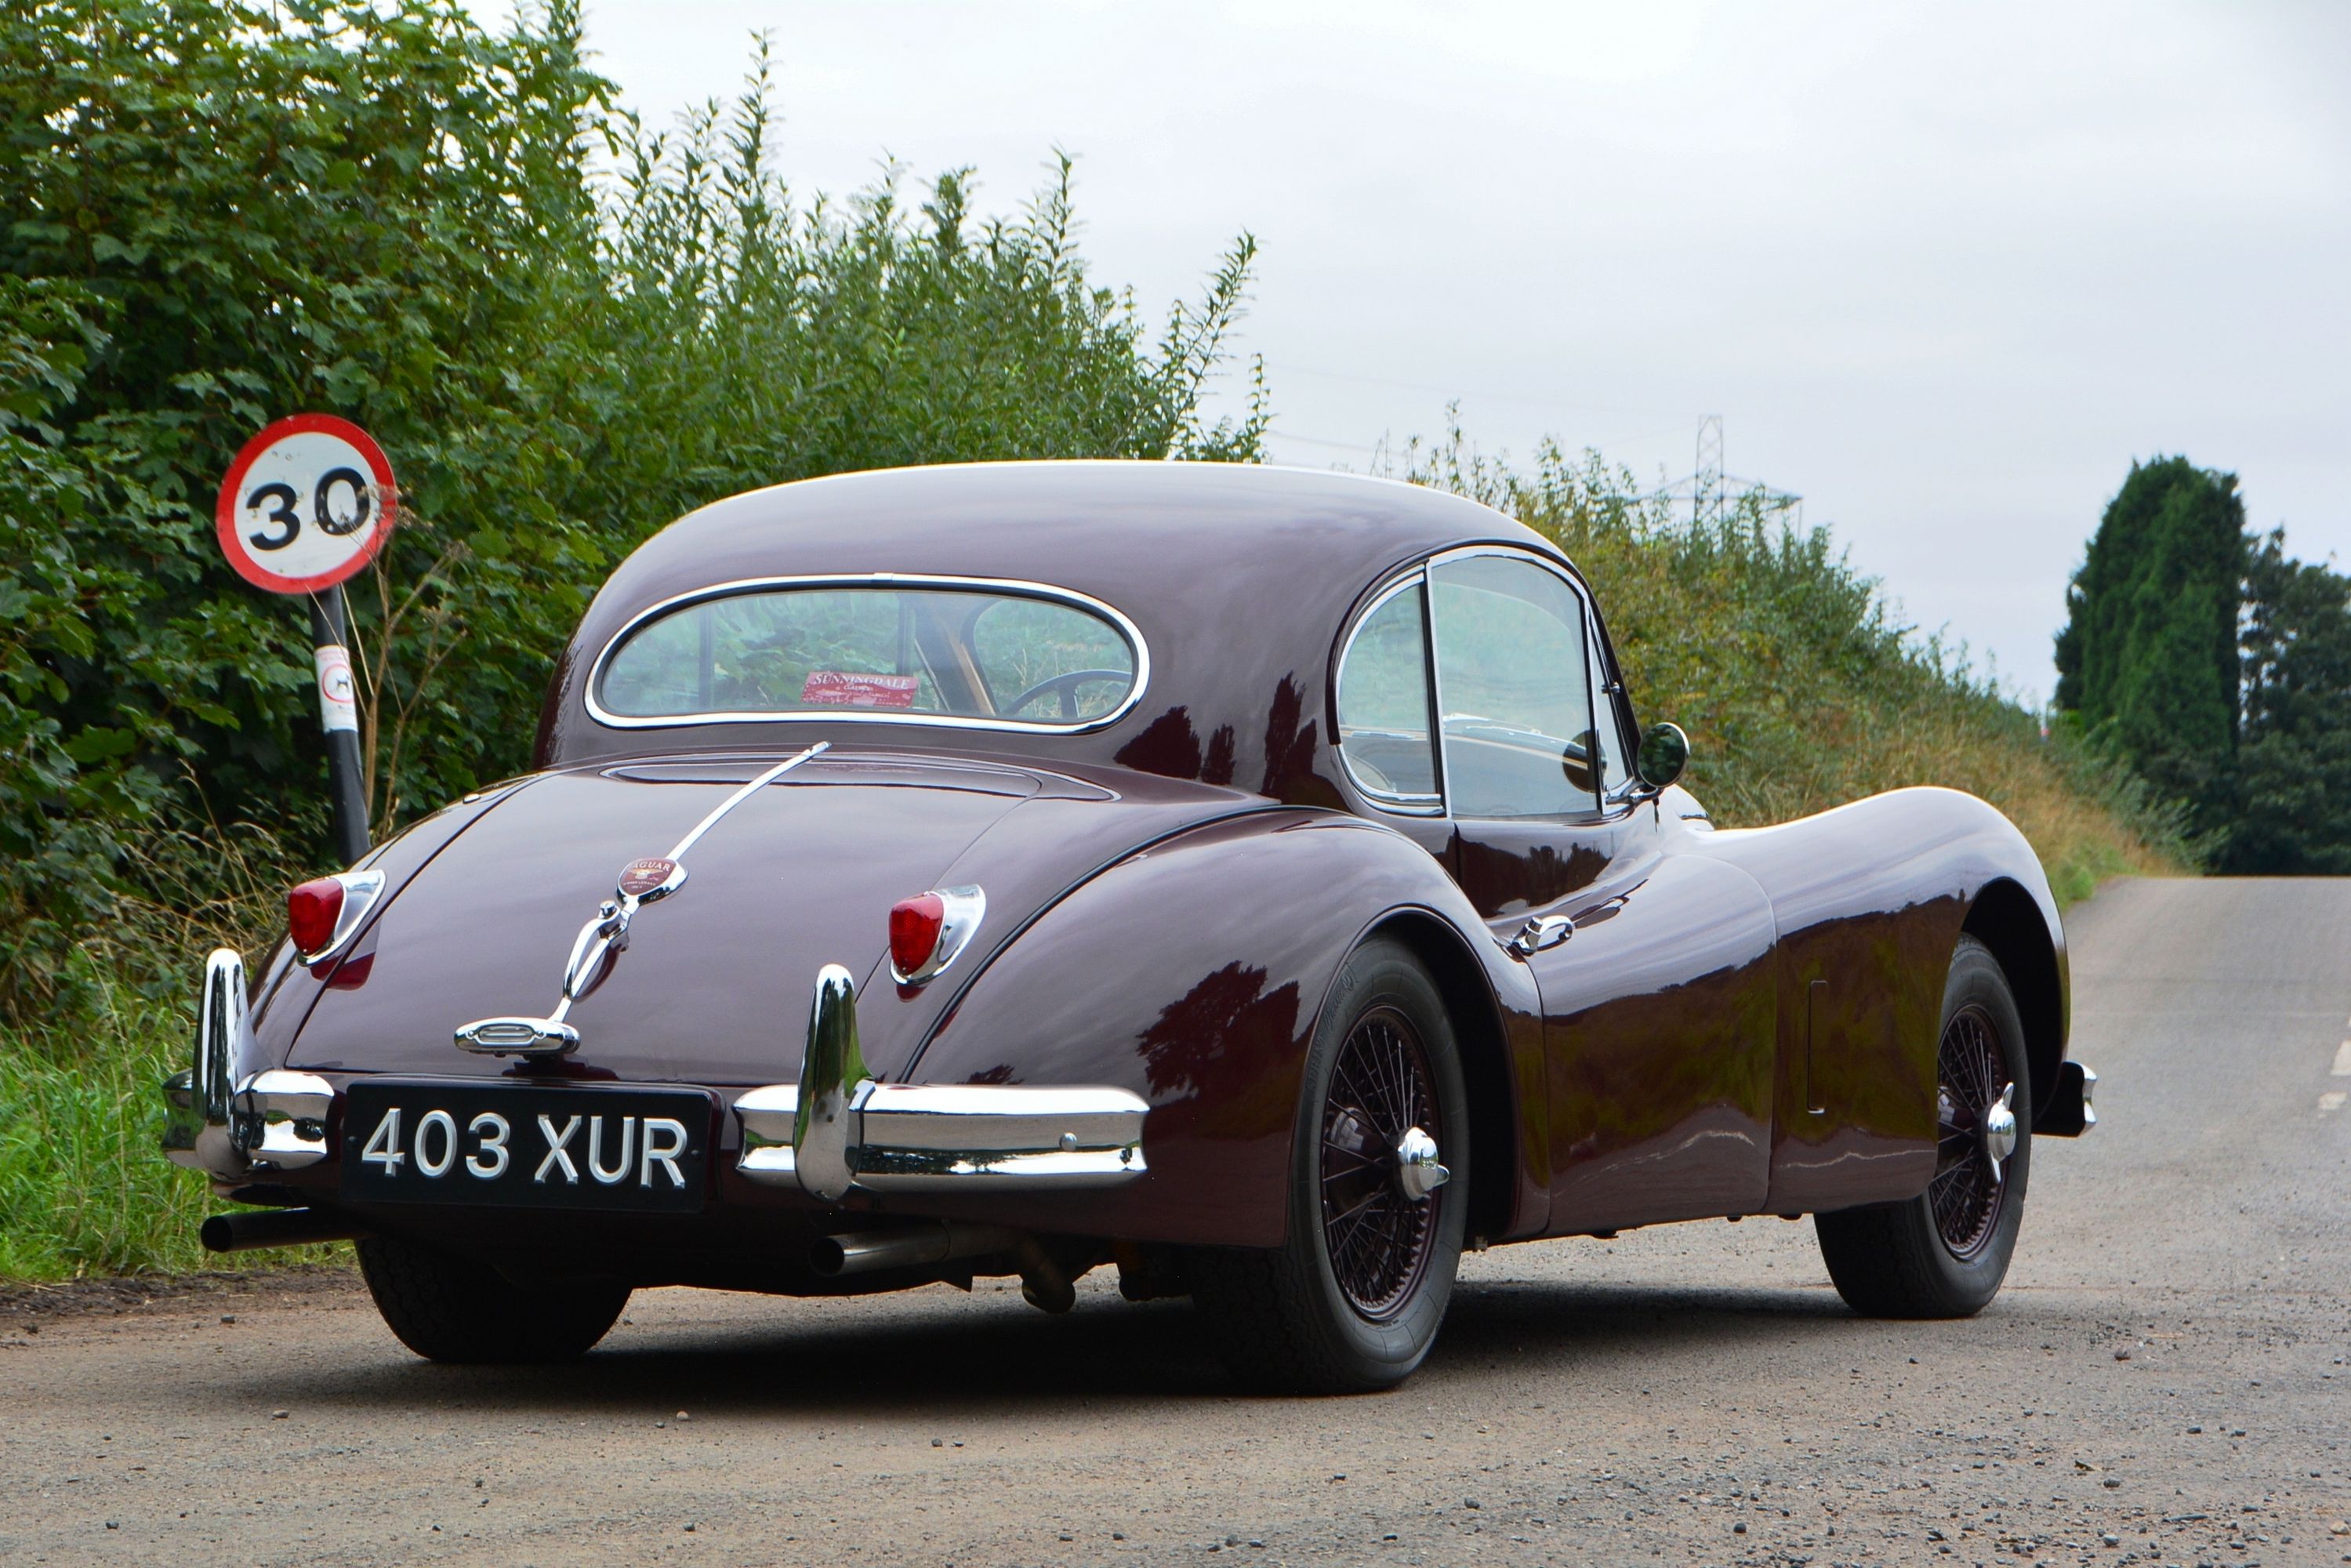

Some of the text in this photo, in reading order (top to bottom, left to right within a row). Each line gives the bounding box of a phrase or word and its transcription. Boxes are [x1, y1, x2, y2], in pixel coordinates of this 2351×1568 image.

[245, 466, 371, 551] 30
[814, 674, 910, 689] SUNNINGDALE
[631, 862, 670, 871] AGUAR
[361, 1107, 688, 1189] 403 XUR
